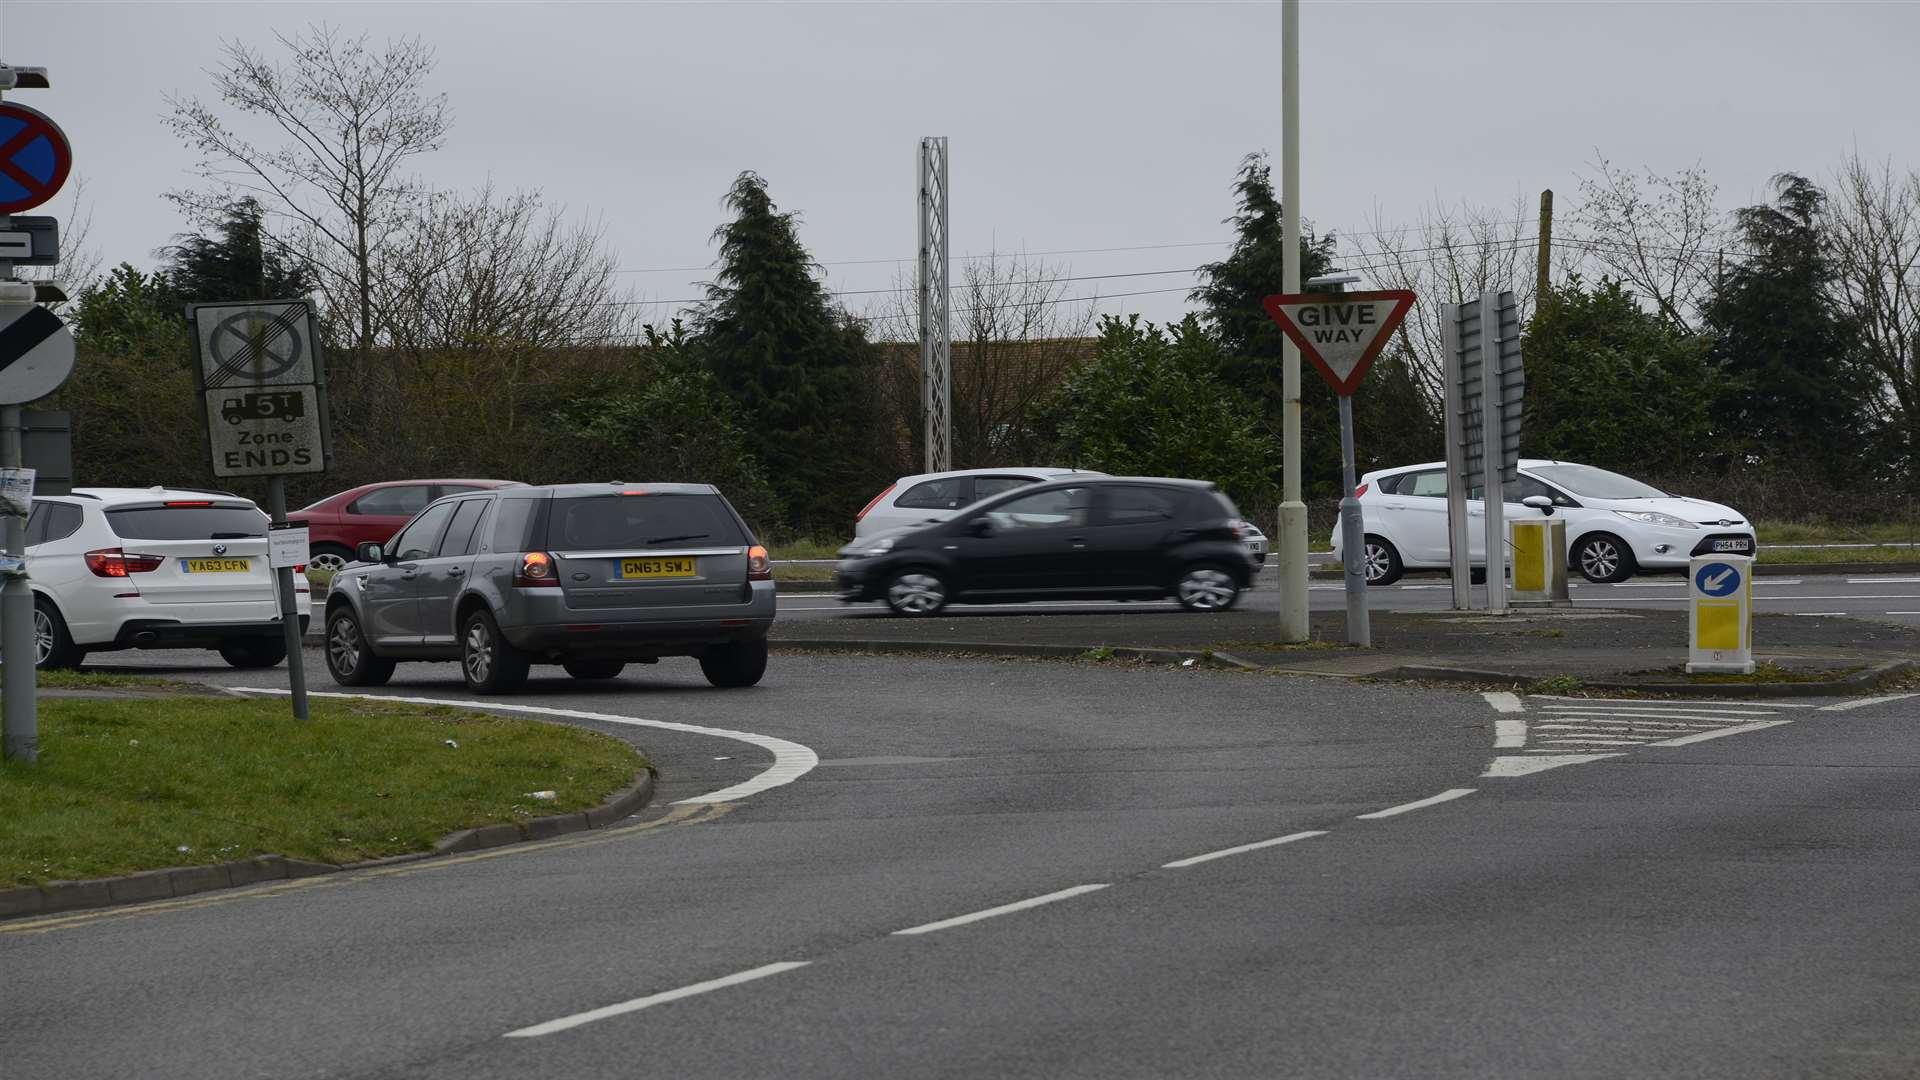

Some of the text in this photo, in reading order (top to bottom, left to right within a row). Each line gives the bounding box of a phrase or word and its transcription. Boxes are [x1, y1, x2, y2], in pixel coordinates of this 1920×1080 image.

[1297, 305, 1376, 327] GIVE
[1314, 329, 1364, 343] WAY
[237, 431, 295, 445] Zone
[225, 448, 312, 469] ENDS
[190, 560, 248, 571] YA63 CFN
[624, 560, 692, 574] GN63 SWJ
